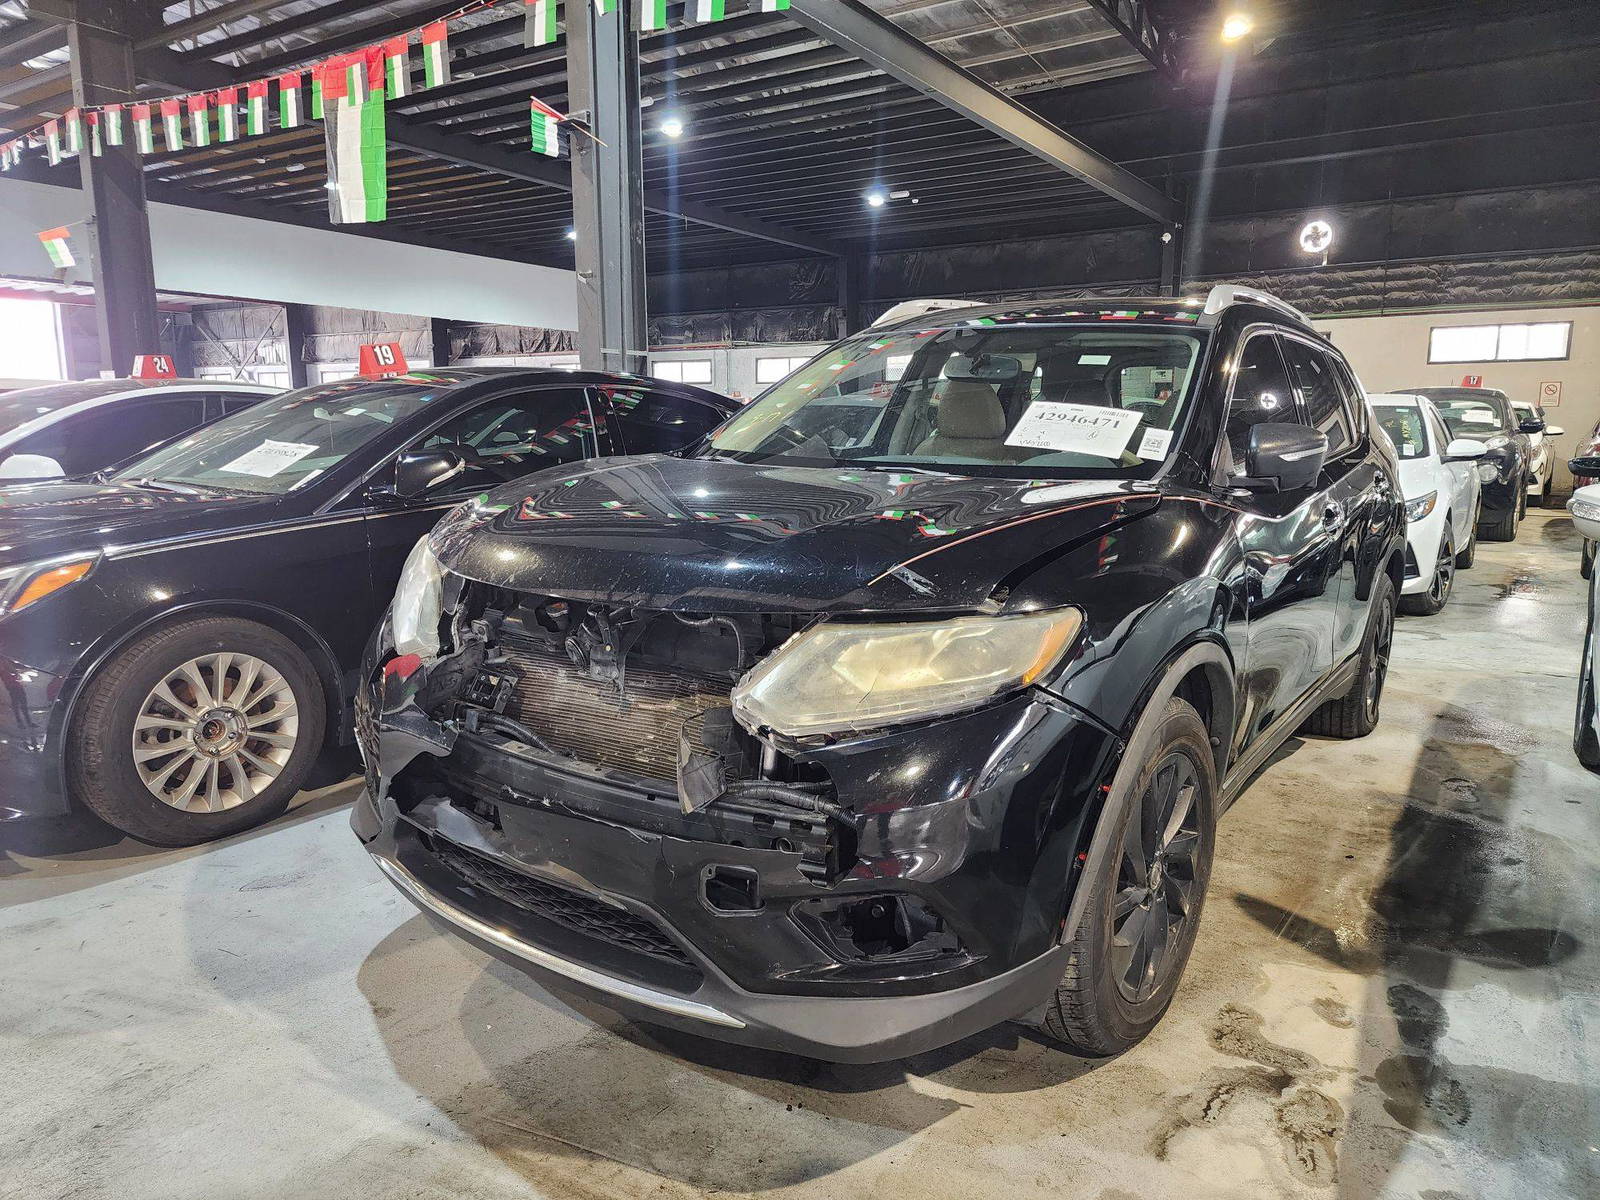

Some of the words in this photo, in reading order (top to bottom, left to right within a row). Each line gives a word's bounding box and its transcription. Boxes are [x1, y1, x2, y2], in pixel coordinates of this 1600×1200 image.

[373, 345, 395, 366] 19
[152, 357, 169, 373] 24
[1470, 376, 1479, 385] 17
[1034, 411, 1121, 429] 42946471
